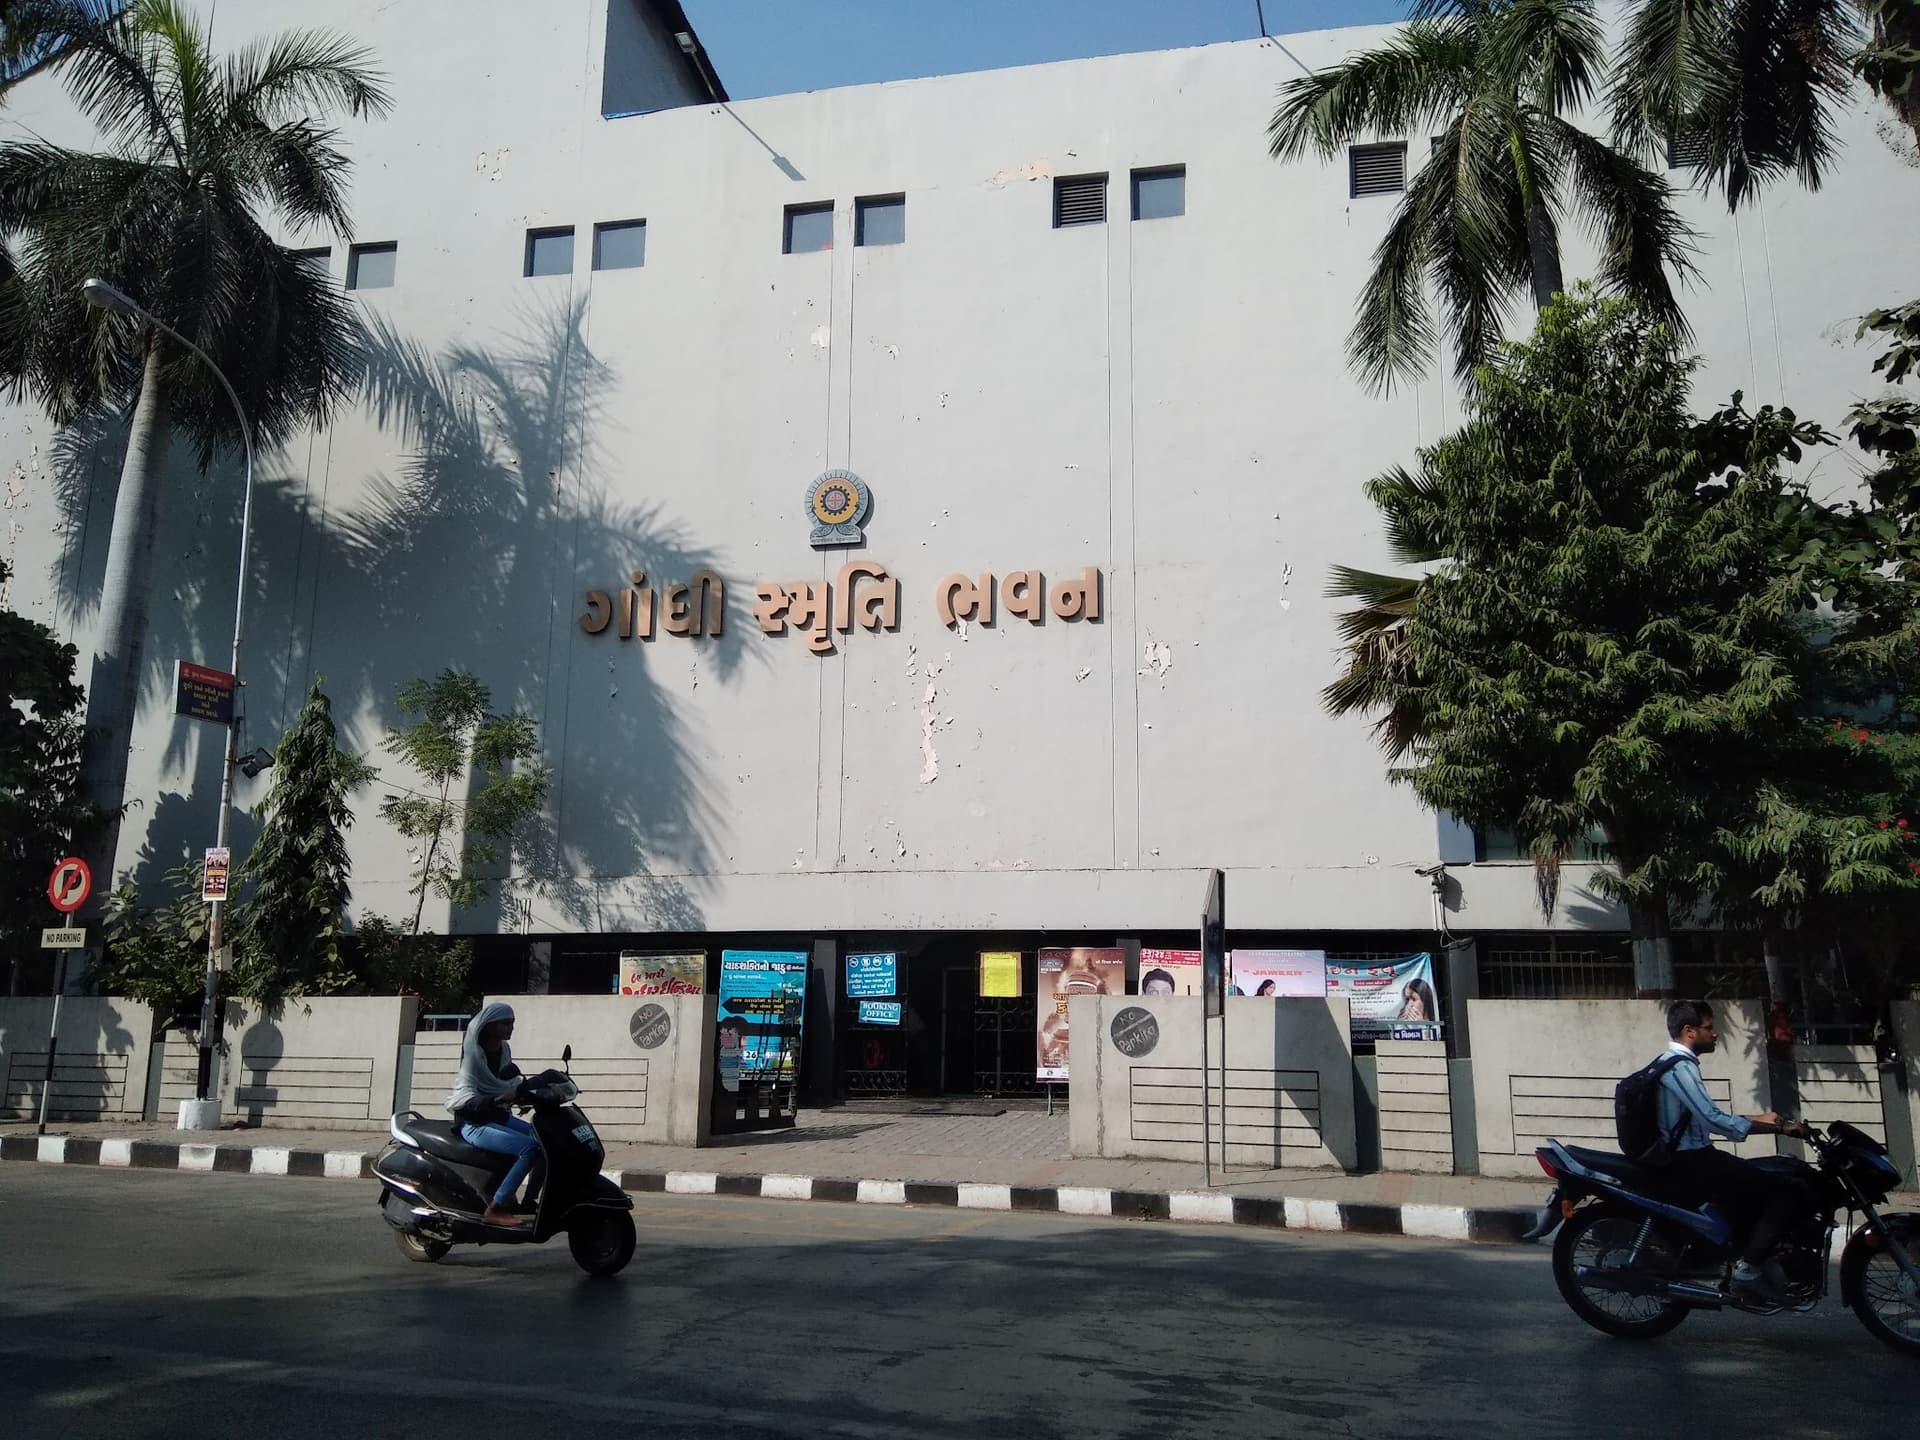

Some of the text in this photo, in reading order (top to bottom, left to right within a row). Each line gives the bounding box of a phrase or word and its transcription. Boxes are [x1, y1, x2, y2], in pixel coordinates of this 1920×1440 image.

[580, 560, 1102, 656] ગાંધી સ્મૃતિ ભવન
[46, 932, 82, 943] NO PARKING
[863, 1002, 898, 1011] BOOKING
[638, 1008, 653, 1023] NO
[866, 1010, 894, 1018] OFFICE
[639, 1020, 668, 1048] Parking
[745, 1051, 757, 1059] 26
